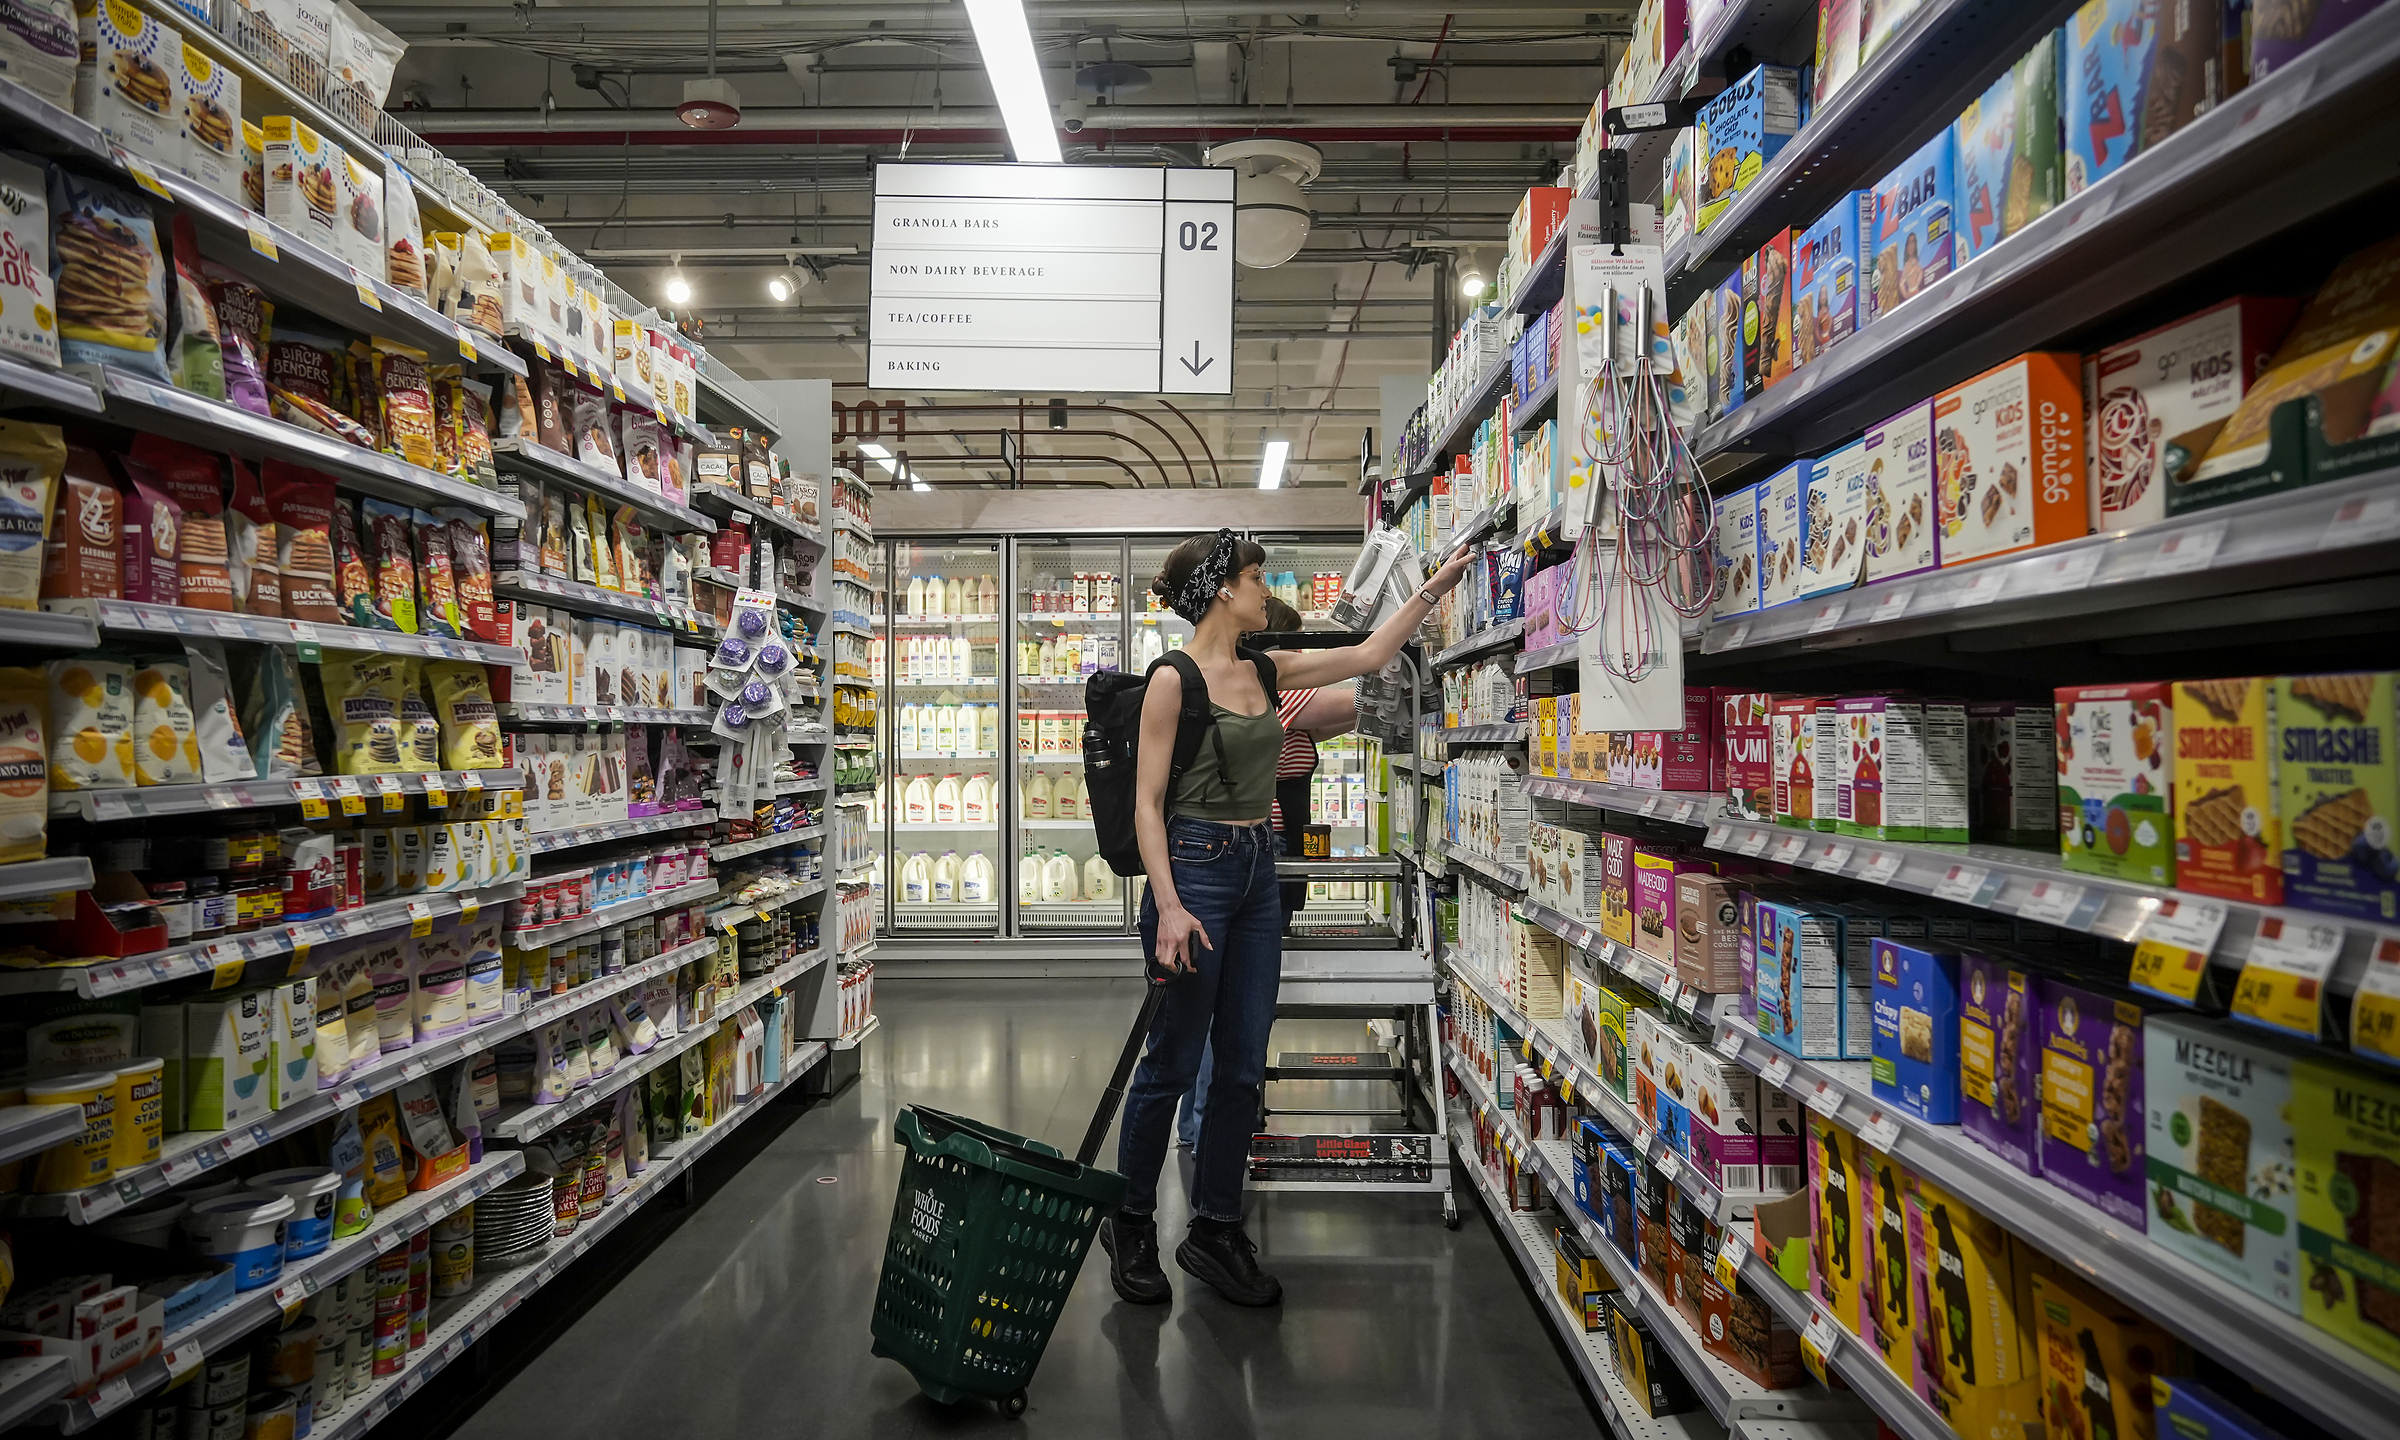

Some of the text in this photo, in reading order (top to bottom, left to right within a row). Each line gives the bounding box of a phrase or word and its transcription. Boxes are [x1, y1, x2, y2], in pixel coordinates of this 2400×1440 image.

[109, 1, 139, 22] Simple
[297, 4, 328, 33] jovial
[352, 33, 374, 58] jovial
[1715, 105, 1749, 134] CHOCOLATE
[1724, 122, 1738, 136] CHIP
[310, 210, 332, 229] PROTEIN
[892, 218, 999, 229] GRANOLA BARS
[1179, 222, 1218, 251] 02
[890, 265, 1044, 277] NON DAIRY BEVERAGE
[1742, 267, 1758, 289] KIND
[224, 288, 256, 312] BIRCH
[888, 313, 972, 324] TEA/COFFEE
[282, 347, 322, 366] BIRCH
[888, 361, 941, 372] BAKING
[272, 359, 330, 386] BENDERS
[393, 360, 426, 376] BIRCH
[385, 373, 428, 394] BENDERS
[1973, 381, 2022, 424] gomacro
[2040, 402, 2059, 504] gomacro
[18, 519, 42, 532] FLOUR
[453, 703, 495, 716] PROTEIN
[1540, 698, 1556, 718] MADE
[1557, 696, 1570, 716] MADE
[1529, 720, 1540, 736] GOOD
[1540, 719, 1556, 737] GOOD
[1557, 718, 1571, 736] GOOD
[1886, 726, 1922, 735] Calories 150
[1927, 728, 1964, 736] Calories 150
[1727, 738, 1767, 762] YUMI
[21, 764, 44, 776] FLOUR
[1606, 838, 1624, 860] MADE
[1547, 863, 1556, 871] CHEWY
[1606, 857, 1623, 878] GOOD
[1637, 870, 1668, 893] MADEGOOD
[1756, 968, 1779, 993] Chewy
[1874, 1000, 1898, 1020] Crispy
[293, 1017, 307, 1027] Corn
[1874, 1015, 1898, 1032] Snack Bars
[242, 1030, 258, 1042] Corn
[291, 1026, 309, 1039] Starch
[239, 1040, 261, 1055] Starch
[2048, 1031, 2088, 1062] Annie's
[2176, 1038, 2254, 1085] MEZCLA
[1316, 1139, 1370, 1149] Little Giant
[1573, 1130, 1584, 1146] KIND
[375, 1142, 396, 1164] EGG
[1350, 1150, 1370, 1158] STEP
[1636, 1175, 1648, 1194] KIND
[1827, 1167, 1846, 1192] BEAR
[915, 1189, 945, 1220] WHOLE
[1668, 1202, 1682, 1223] KIND
[910, 1210, 941, 1237] FOODS
[1883, 1206, 1902, 1231] BEAR
[911, 1228, 933, 1244] MARKET
[1669, 1228, 1686, 1247] SQUARES
[1704, 1252, 1716, 1264] SOFT
[1938, 1246, 1964, 1280] BEAR
[1596, 1295, 1606, 1328] KIND
[2084, 1368, 2110, 1400] BEAR
